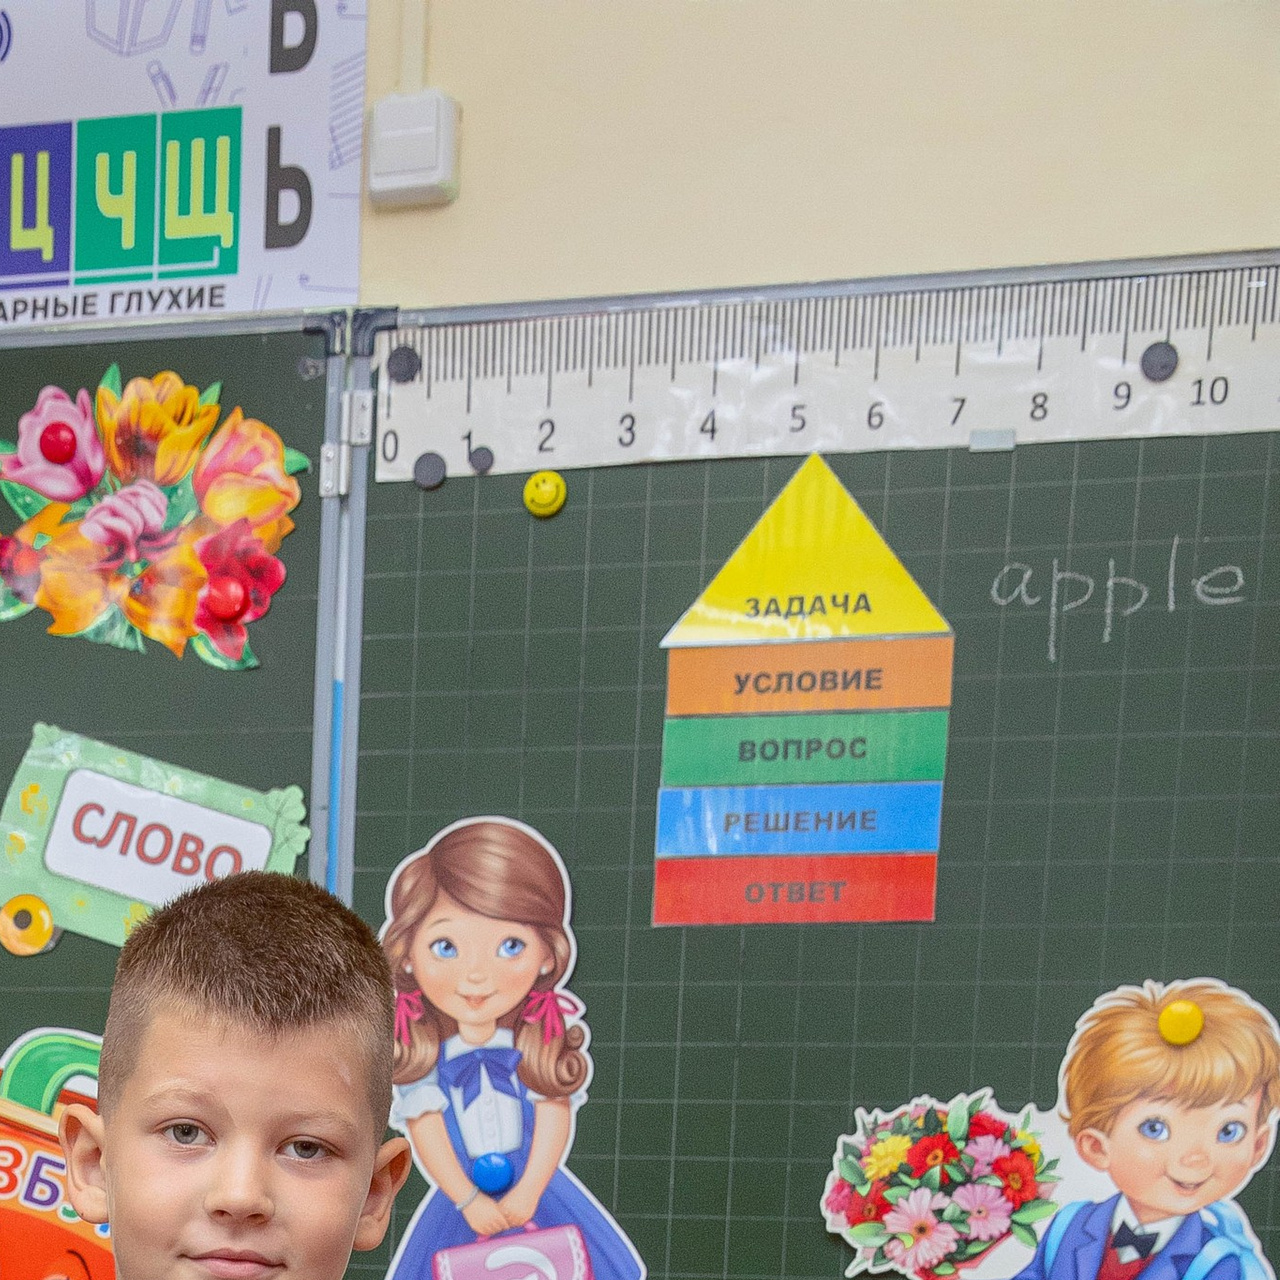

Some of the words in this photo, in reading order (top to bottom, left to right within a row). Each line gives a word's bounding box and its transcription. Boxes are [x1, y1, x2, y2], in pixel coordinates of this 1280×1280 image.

[10, 151, 54, 262] Ц
[95, 150, 137, 250] Ч
[164, 135, 234, 249] Щ
[265, 124, 312, 250] Ь
[108, 284, 225, 315] ГЛУХИЕ
[383, 429, 399, 462] 0
[537, 418, 556, 452] 2
[618, 413, 636, 447] 3
[700, 408, 717, 440] 4
[789, 405, 807, 433] 5
[867, 402, 884, 430] 6
[950, 397, 966, 426] 7
[1030, 392, 1049, 420] 8
[1114, 381, 1132, 410] 9
[1190, 376, 1229, 407] 10
[745, 592, 872, 619] ЗАДАЧА
[990, 533, 1245, 663] apple
[734, 668, 883, 696] УСЛОВИЕ
[738, 737, 867, 762] ВОПРОС
[723, 809, 878, 833] РЕШЕНИЕ
[71, 801, 243, 883] СЛОВО
[744, 881, 847, 904] ОТВЕТ
